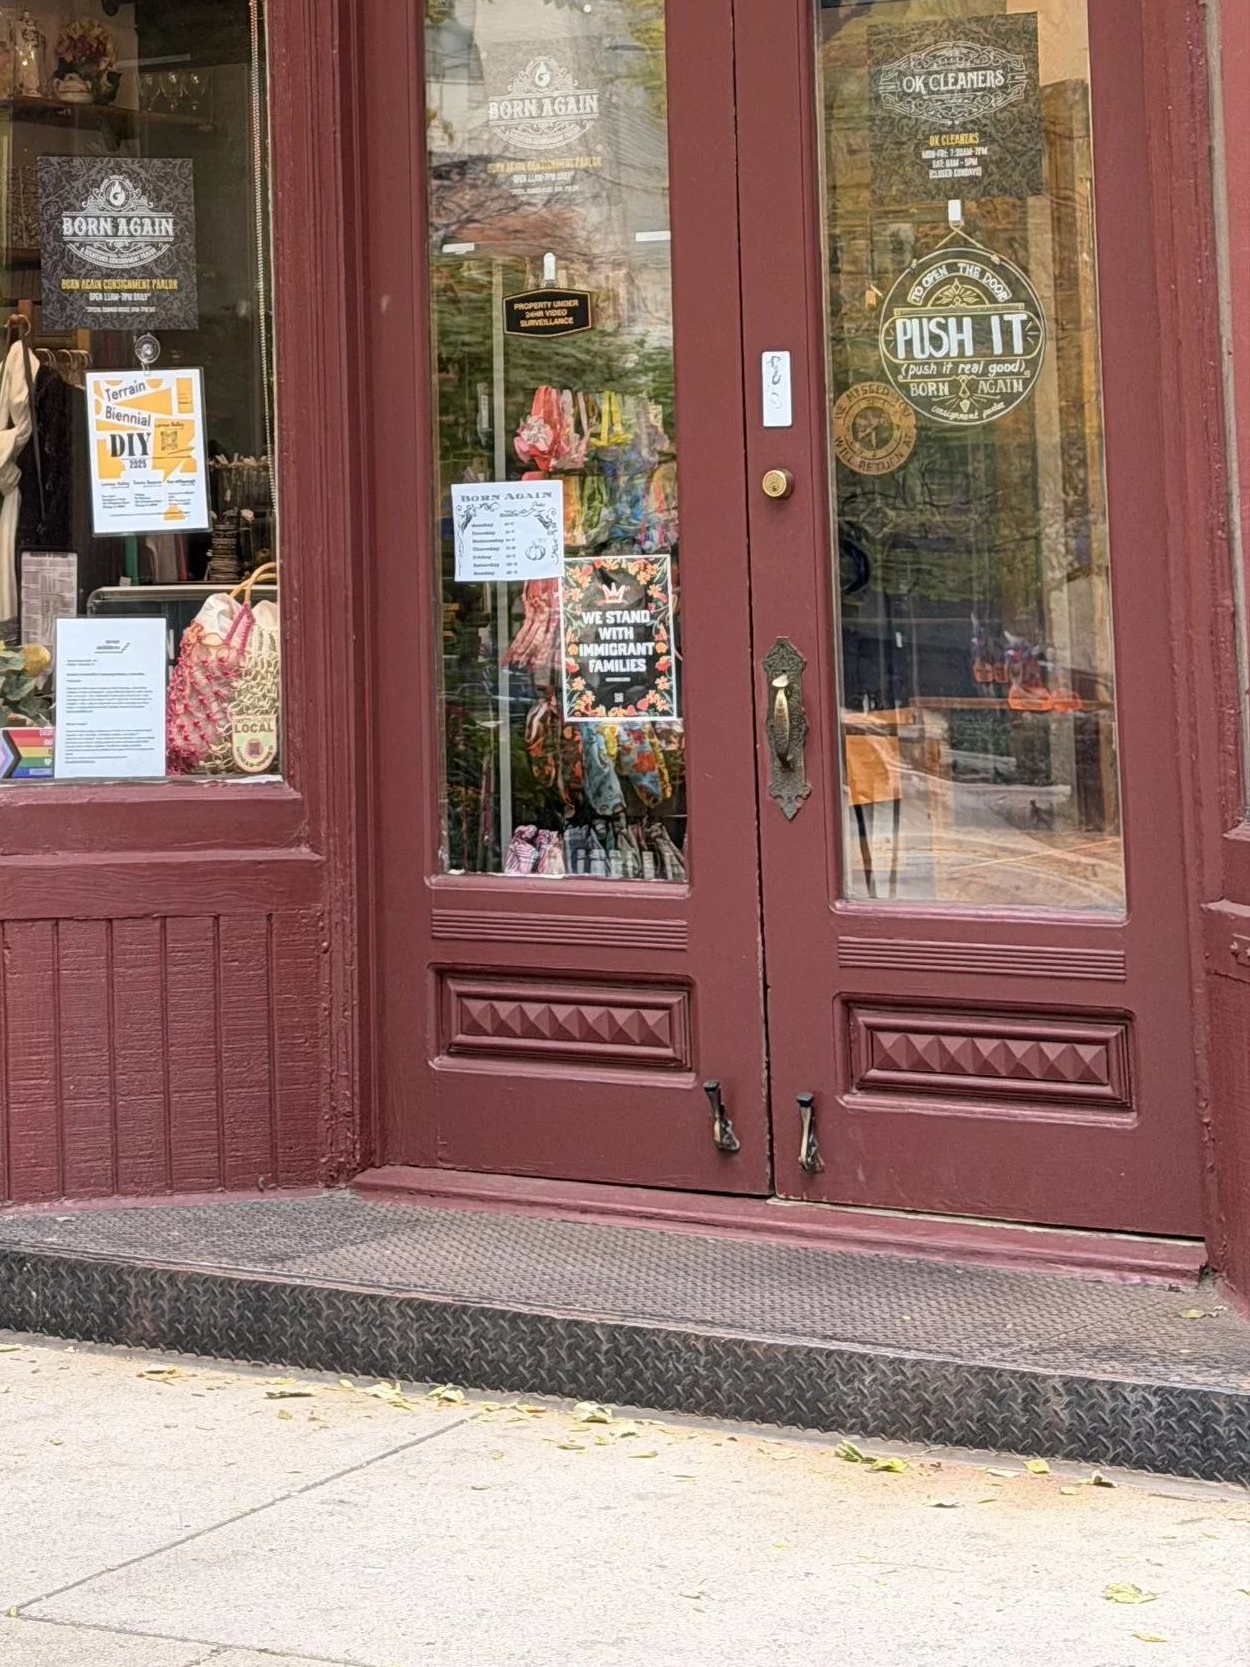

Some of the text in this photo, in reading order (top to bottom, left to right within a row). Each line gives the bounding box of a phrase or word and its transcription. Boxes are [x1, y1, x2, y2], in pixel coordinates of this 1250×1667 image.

[902, 70, 1005, 94] OK CLEANERS
[489, 94, 599, 120] BORN AGAIN
[929, 132, 980, 146] OK CLEANERS
[62, 216, 174, 236] BORN AGAIN
[911, 263, 1008, 303] TO OPEN THE DOOR
[513, 299, 579, 310] PROPERTY UNDER
[545, 308, 568, 317] VIDEO
[520, 317, 574, 327] SURVEILLANCE
[895, 313, 1027, 359] PUSH IT
[901, 359, 1025, 379] (push it real good)
[105, 380, 146, 402] Terrain
[846, 384, 890, 402] MISSED
[910, 379, 1023, 396] BORN AGAIN
[106, 405, 151, 427] Biennial
[110, 432, 152, 458] DIY
[129, 459, 147, 469] 2025
[461, 492, 552, 502] BORN AGAIN
[582, 610, 650, 624] WE STAND
[598, 627, 634, 640] WITH
[579, 642, 655, 657] IMMIGRANT
[588, 658, 647, 673] FAMILIES
[235, 723, 274, 733] LOCAL
